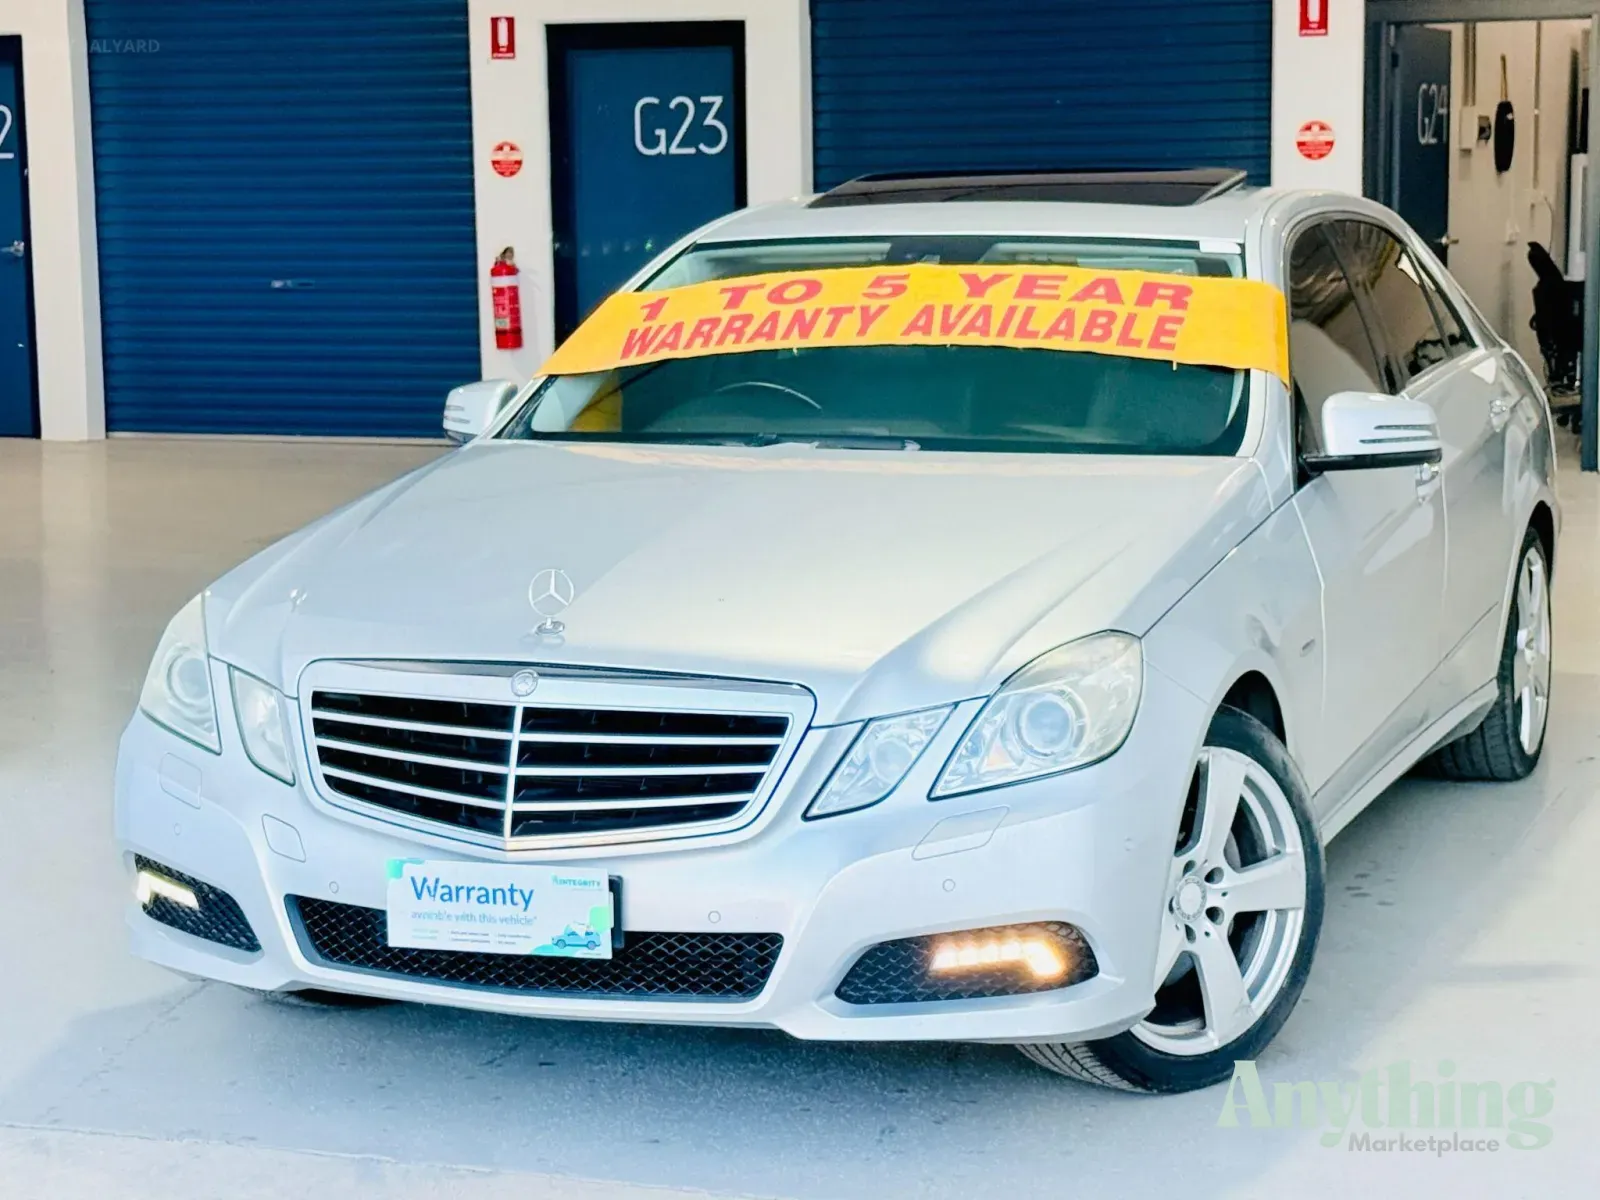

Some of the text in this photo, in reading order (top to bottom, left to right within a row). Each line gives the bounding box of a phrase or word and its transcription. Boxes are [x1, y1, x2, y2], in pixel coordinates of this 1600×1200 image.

[633, 95, 729, 156] G23
[1417, 84, 1447, 145] G24
[640, 273, 1193, 322] 1 TO 5 YEAR
[620, 304, 1185, 360] WARRANTY AVAILABLE
[410, 875, 535, 911] Warranty
